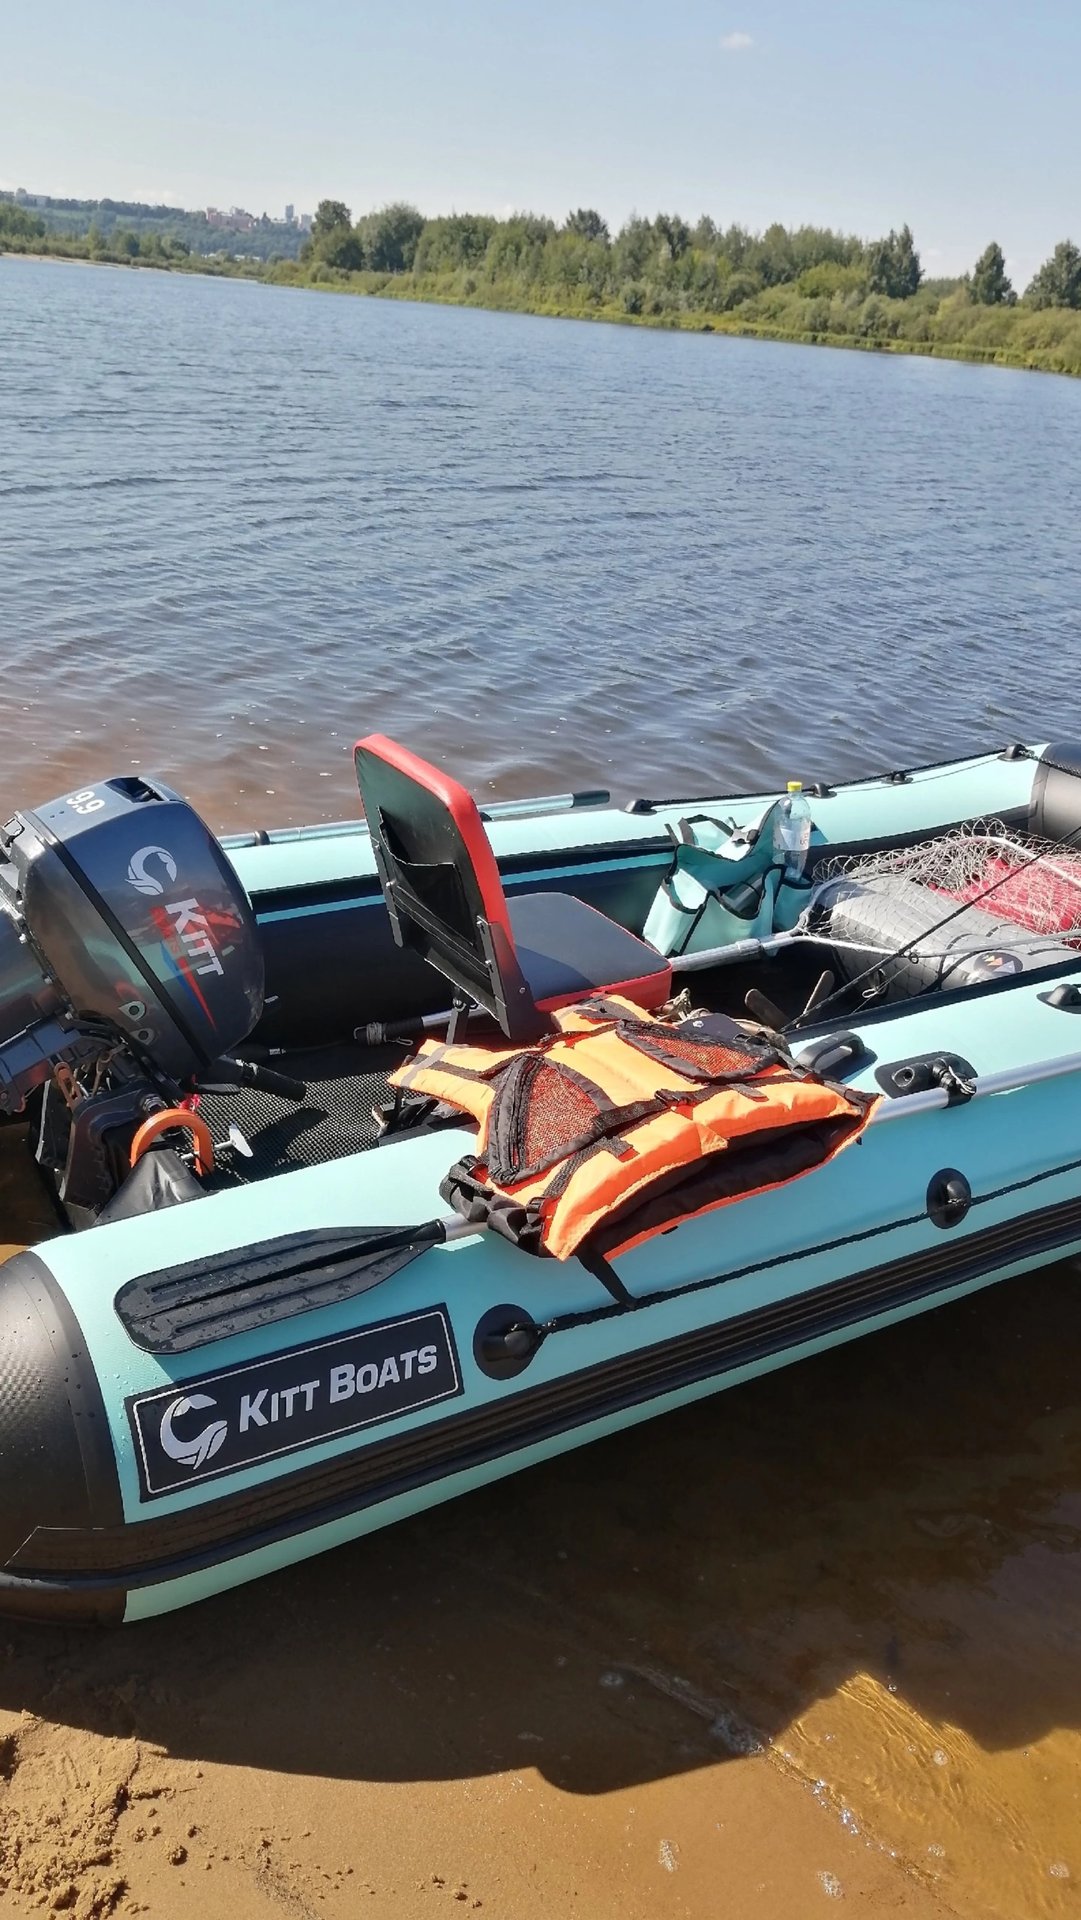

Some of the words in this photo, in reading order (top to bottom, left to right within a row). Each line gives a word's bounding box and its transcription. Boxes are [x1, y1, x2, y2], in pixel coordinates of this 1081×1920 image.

[66, 790, 106, 815] 9.9
[165, 898, 224, 976] KITT
[239, 1380, 320, 1433] KITT
[329, 1345, 438, 1404] BOATS
